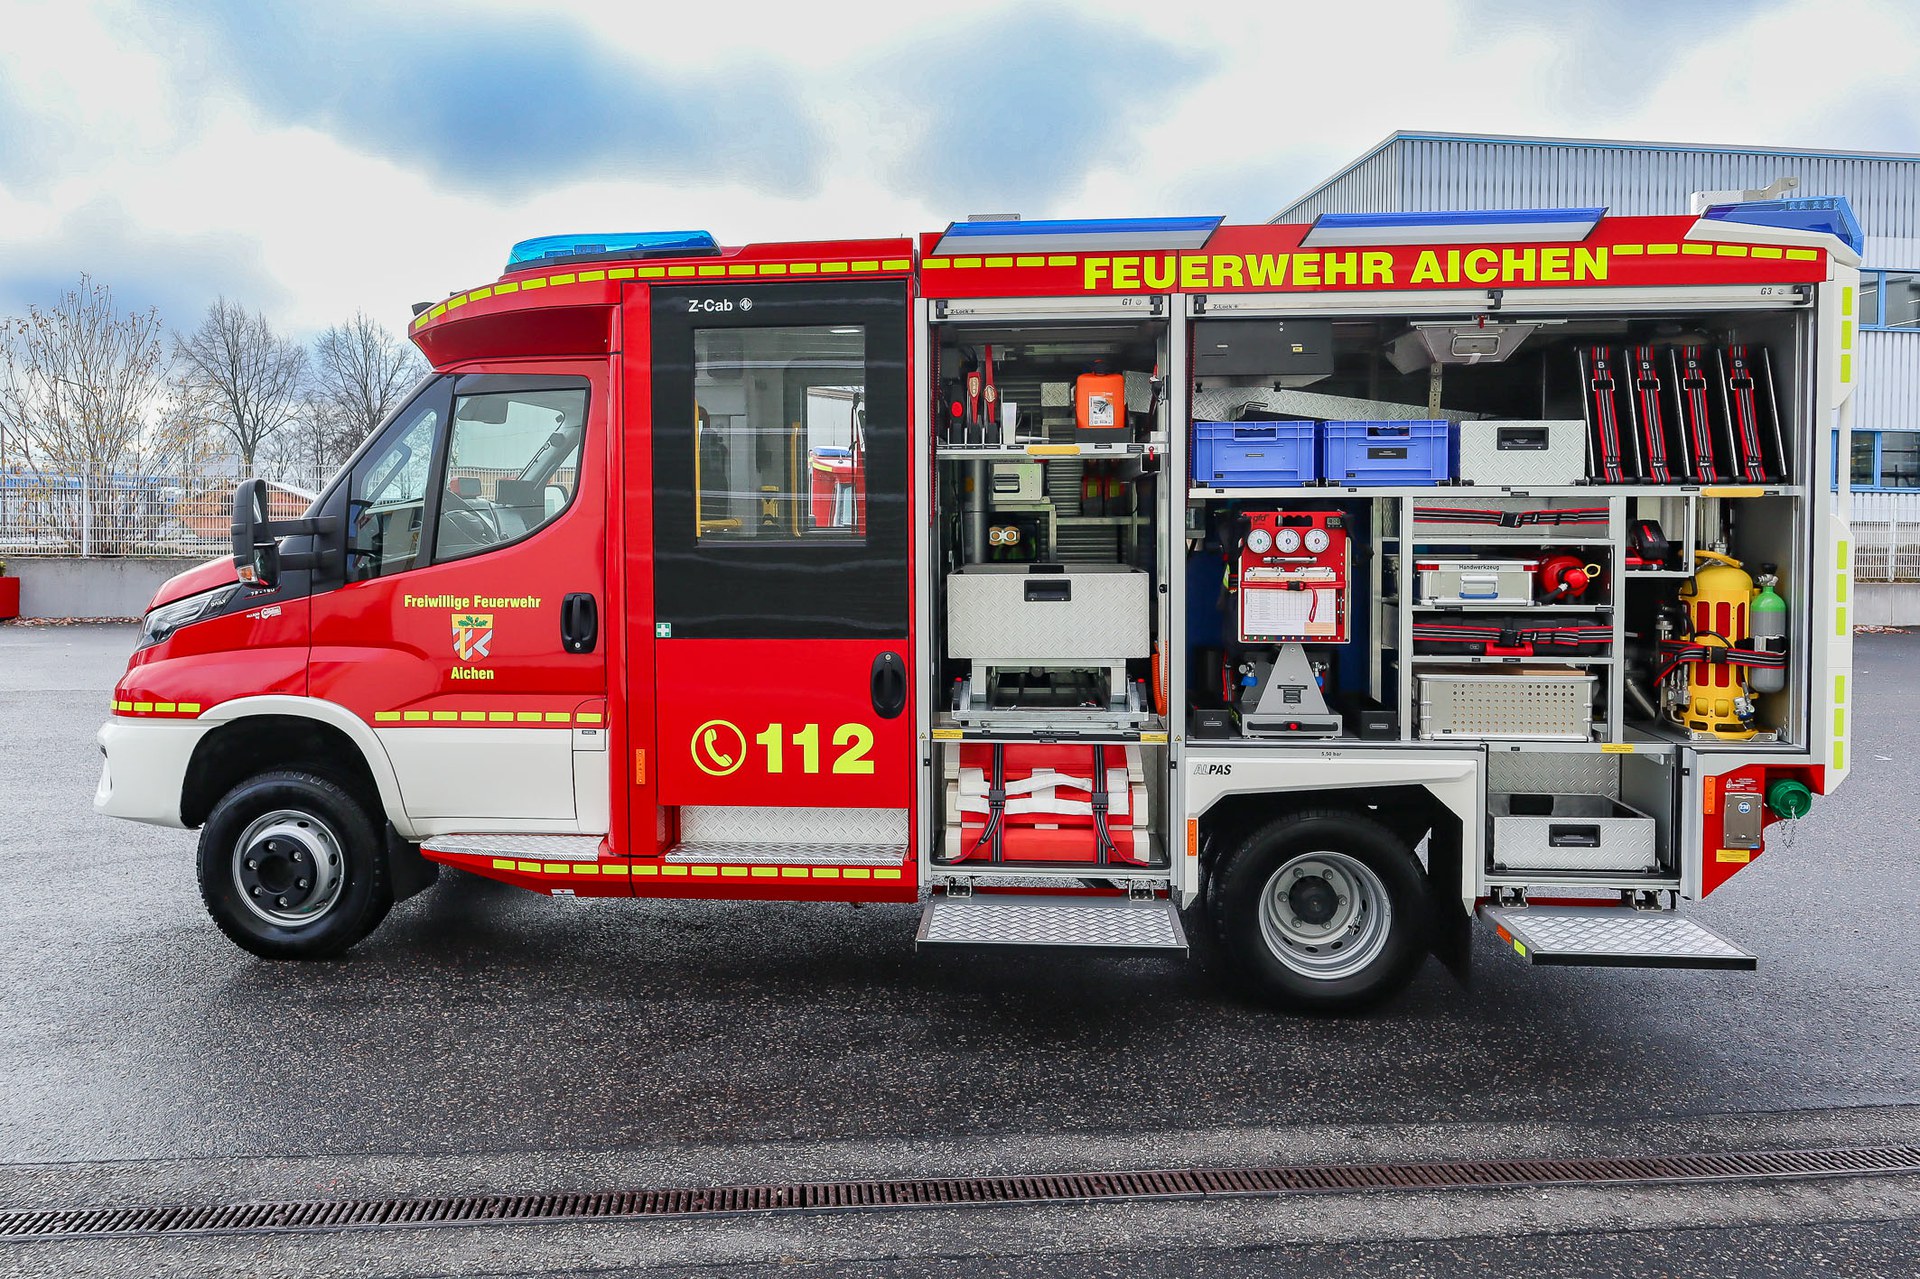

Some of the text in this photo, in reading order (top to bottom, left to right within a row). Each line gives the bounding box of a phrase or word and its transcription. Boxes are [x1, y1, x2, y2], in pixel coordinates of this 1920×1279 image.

[1083, 247, 1608, 290] FEUERWEHR AICHEN
[1760, 287, 1772, 295] G3
[688, 299, 733, 312] Z-Cab
[1122, 298, 1133, 306] G1
[404, 594, 541, 610] Freiwillige Feuerwehr
[451, 666, 494, 679] Aichen
[755, 722, 875, 774] 112
[1193, 764, 1232, 775] ALPAS
